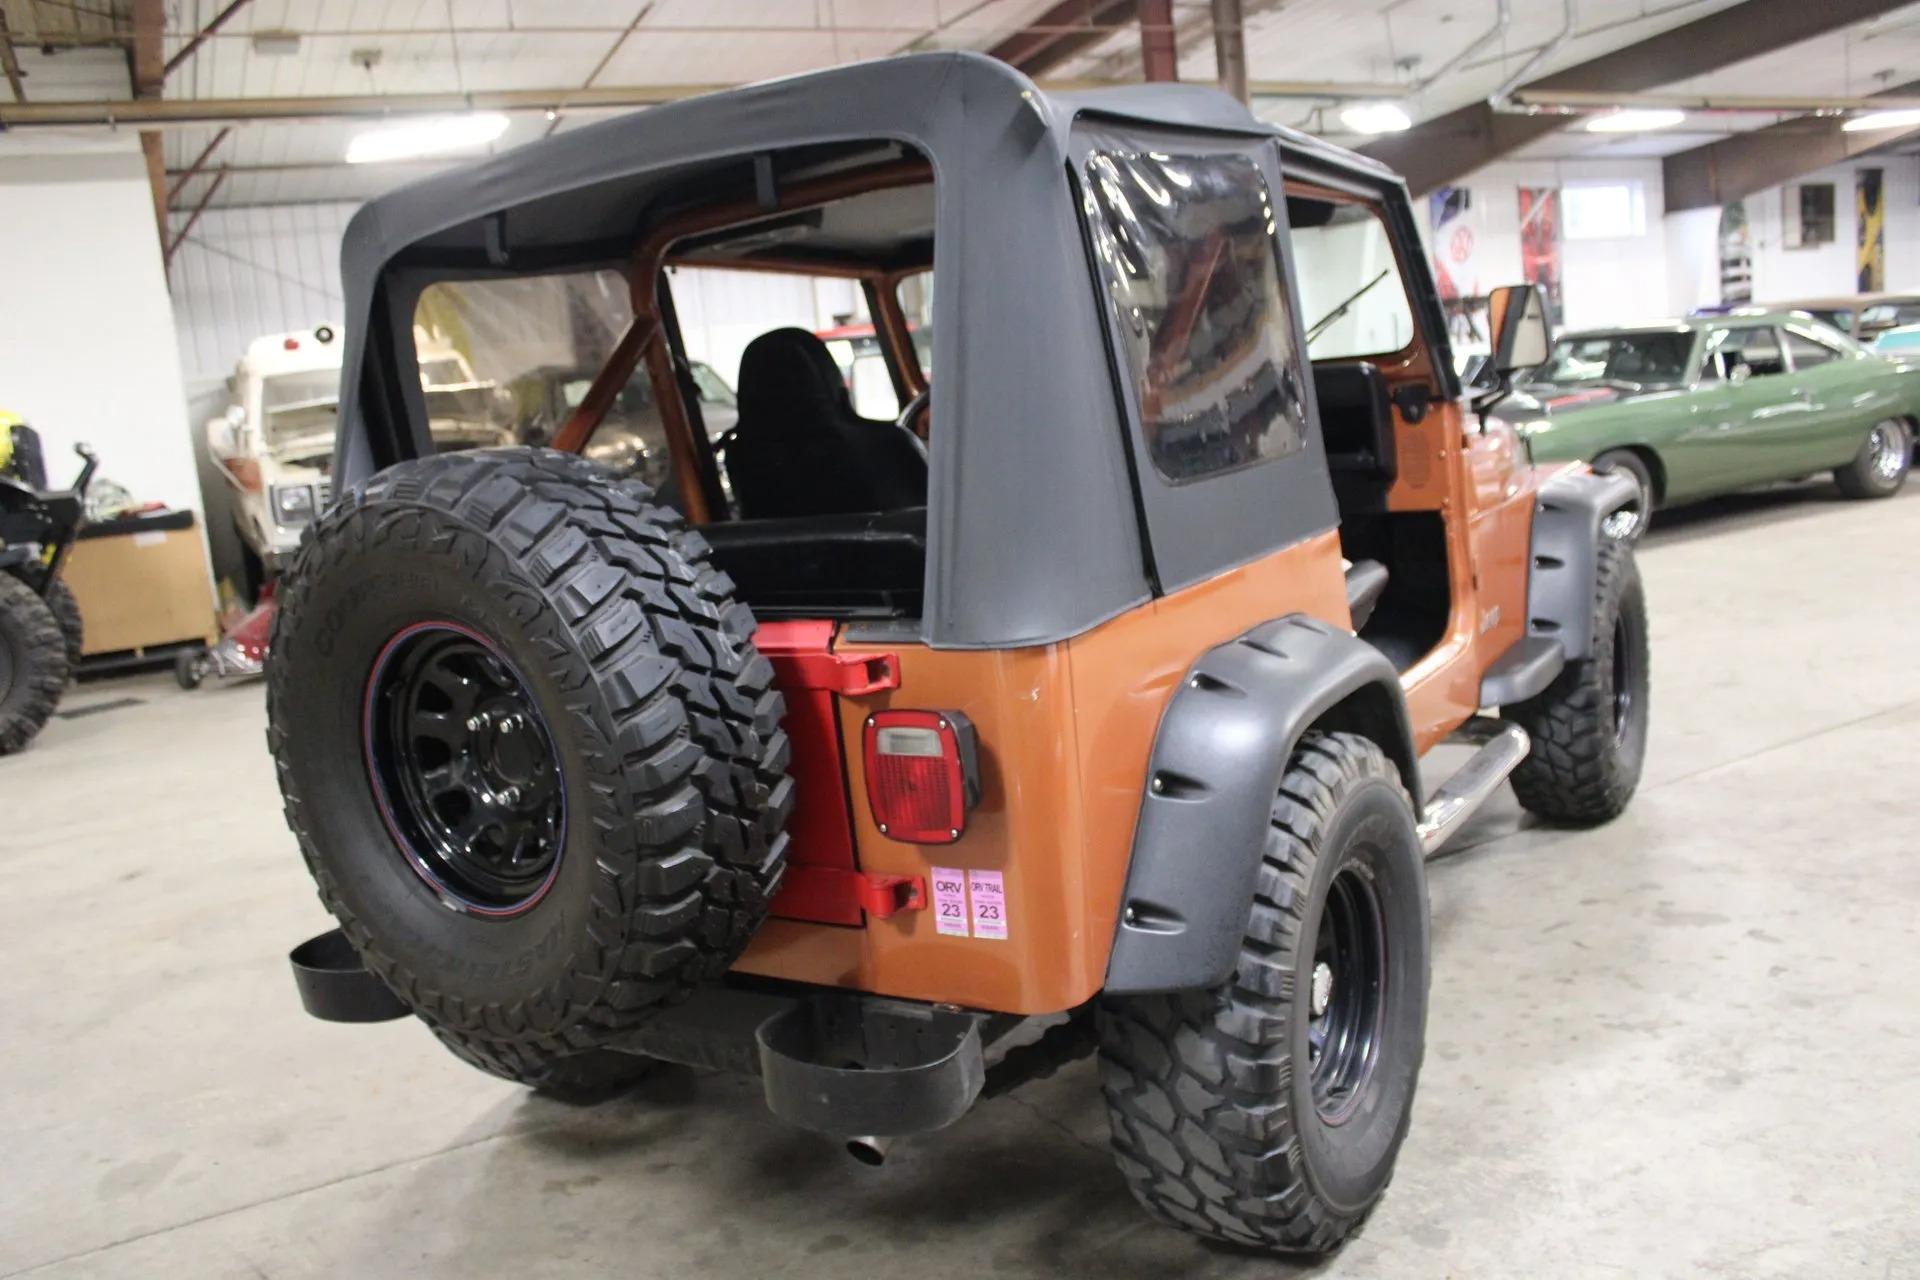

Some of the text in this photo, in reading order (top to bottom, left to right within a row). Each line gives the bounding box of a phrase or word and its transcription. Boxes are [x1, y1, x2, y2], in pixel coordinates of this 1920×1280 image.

[936, 881, 961, 893] ORV
[942, 903, 961, 918] 23
[979, 905, 999, 920] 23
